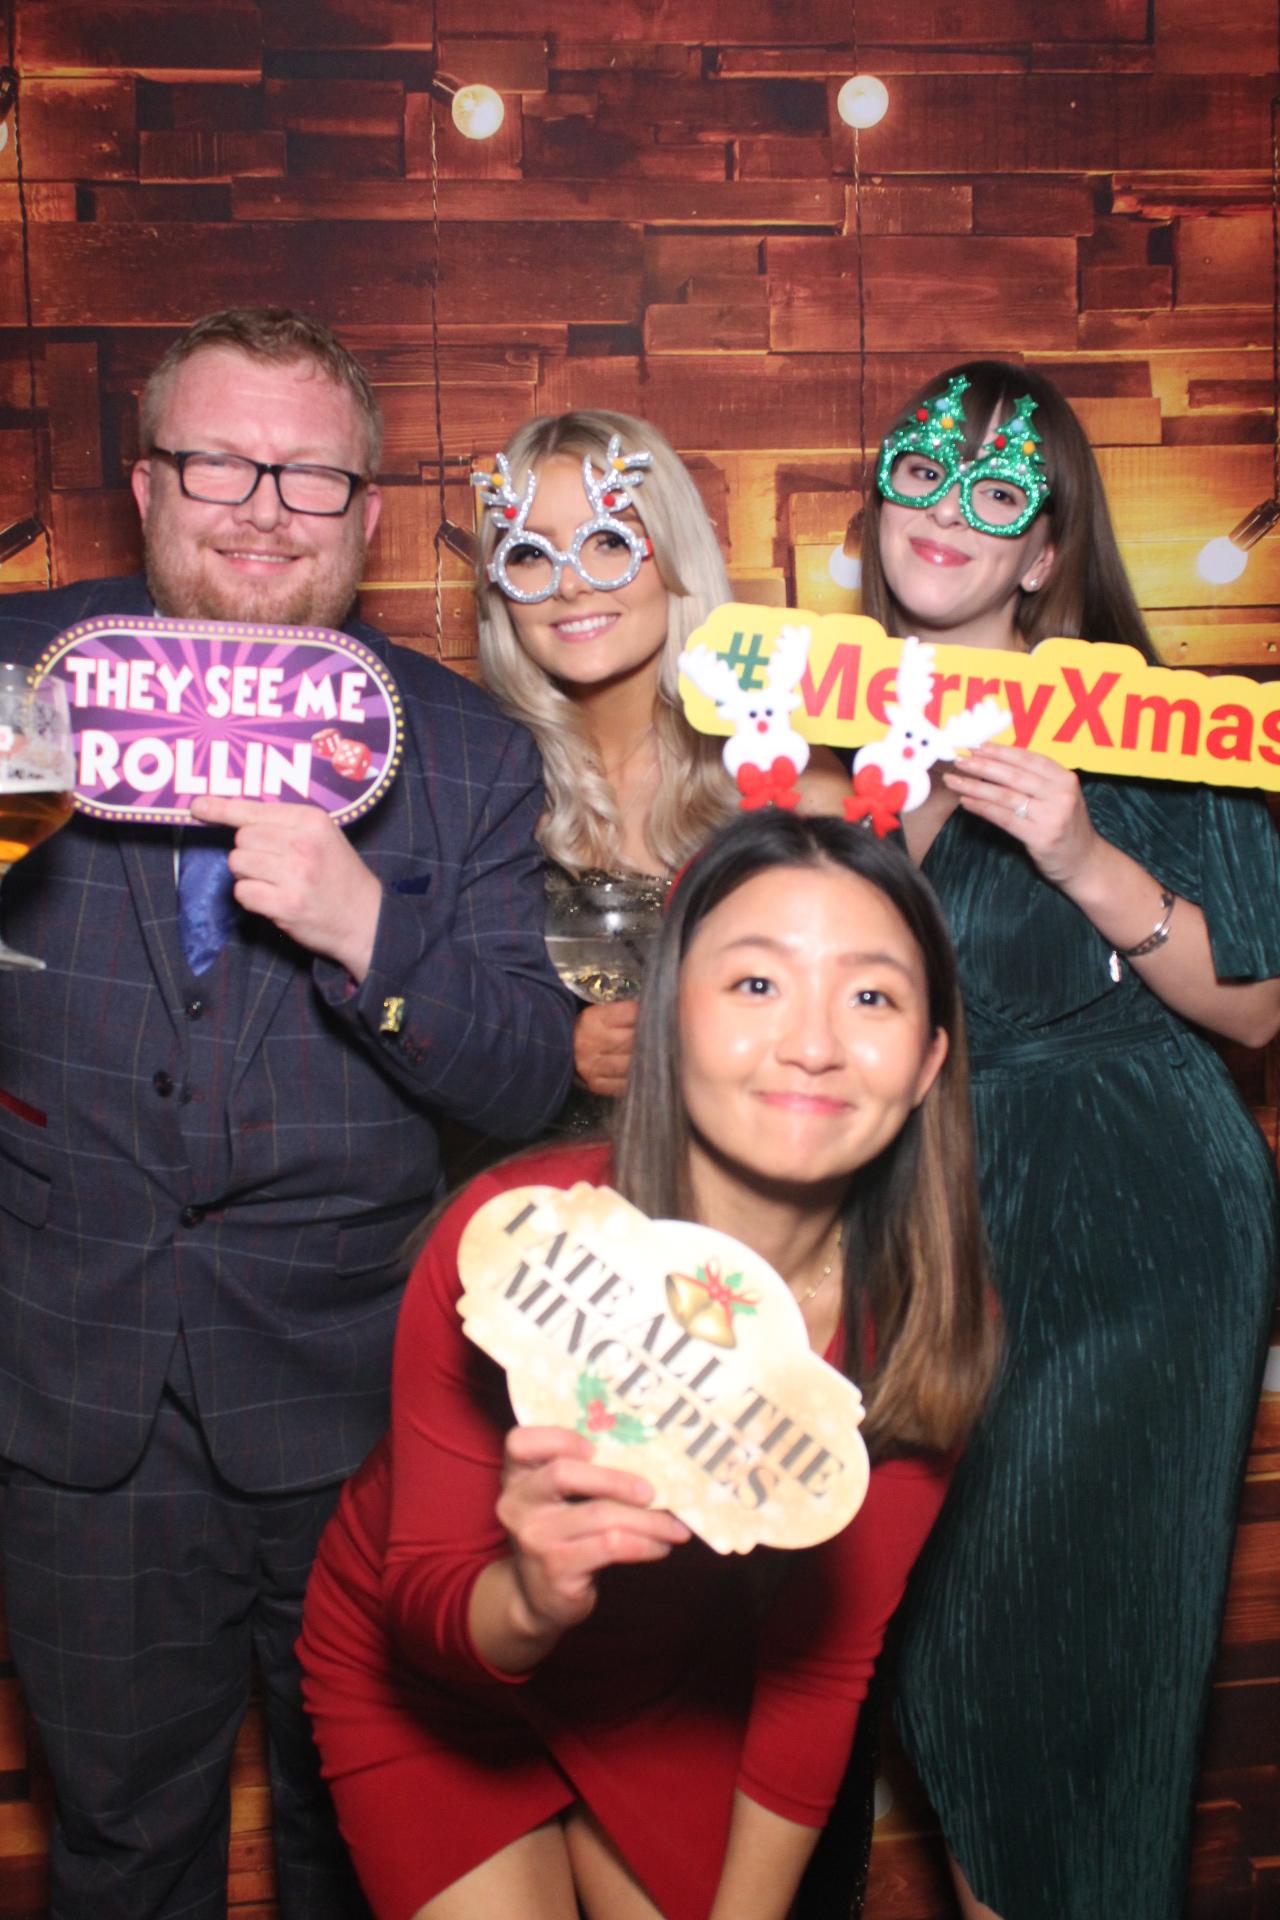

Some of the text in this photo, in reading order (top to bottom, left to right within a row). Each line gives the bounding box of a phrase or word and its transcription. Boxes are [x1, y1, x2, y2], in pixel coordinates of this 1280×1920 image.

[65, 656, 368, 723] THEY SEE ME
[79, 729, 313, 798] ROLLIN
[492, 1260, 781, 1509] MINCE PIES
[504, 1202, 845, 1498] I ATE ALL THE
